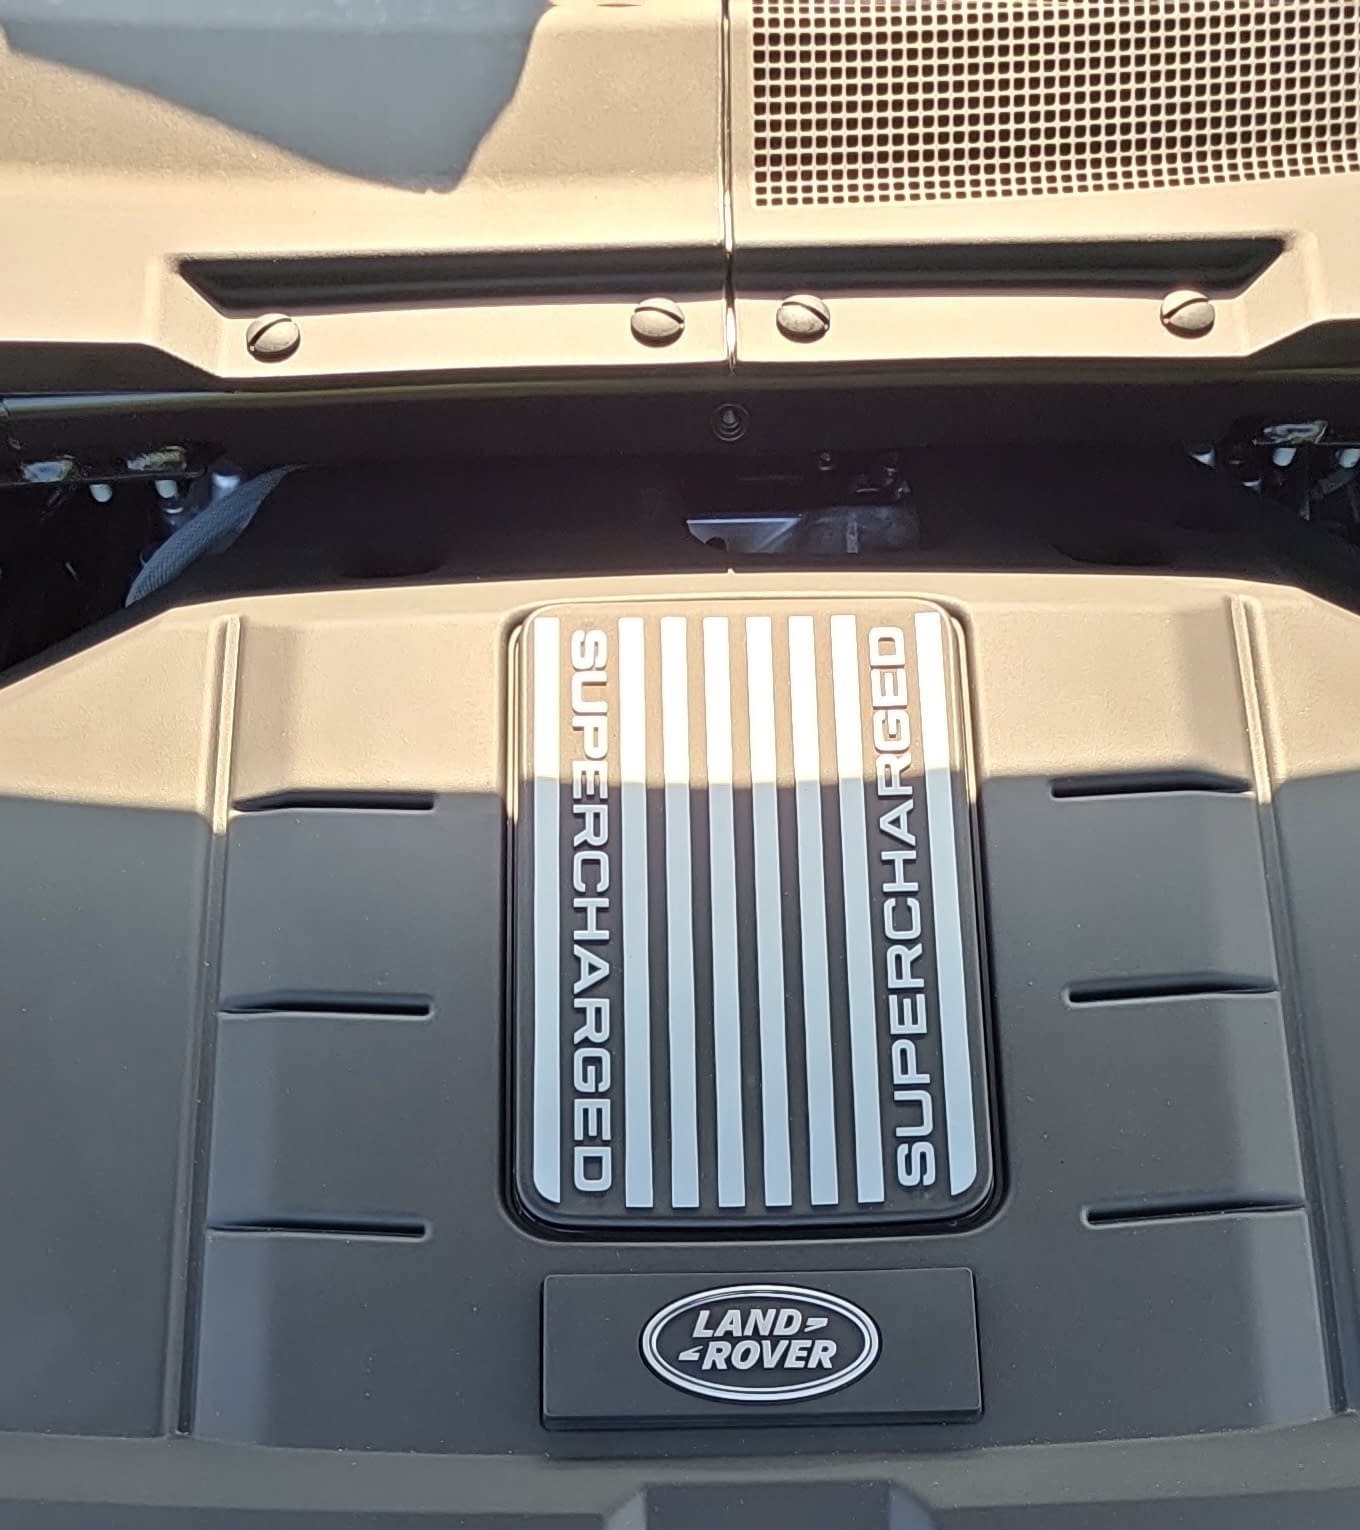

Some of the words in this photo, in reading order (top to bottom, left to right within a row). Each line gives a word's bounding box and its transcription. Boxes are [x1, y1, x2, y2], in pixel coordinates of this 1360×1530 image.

[570, 629, 613, 1192] SUPERCHARGED
[868, 624, 936, 1188] SUPERCHARGED
[692, 1309, 803, 1338] LAND
[701, 1339, 838, 1370] ROVER
